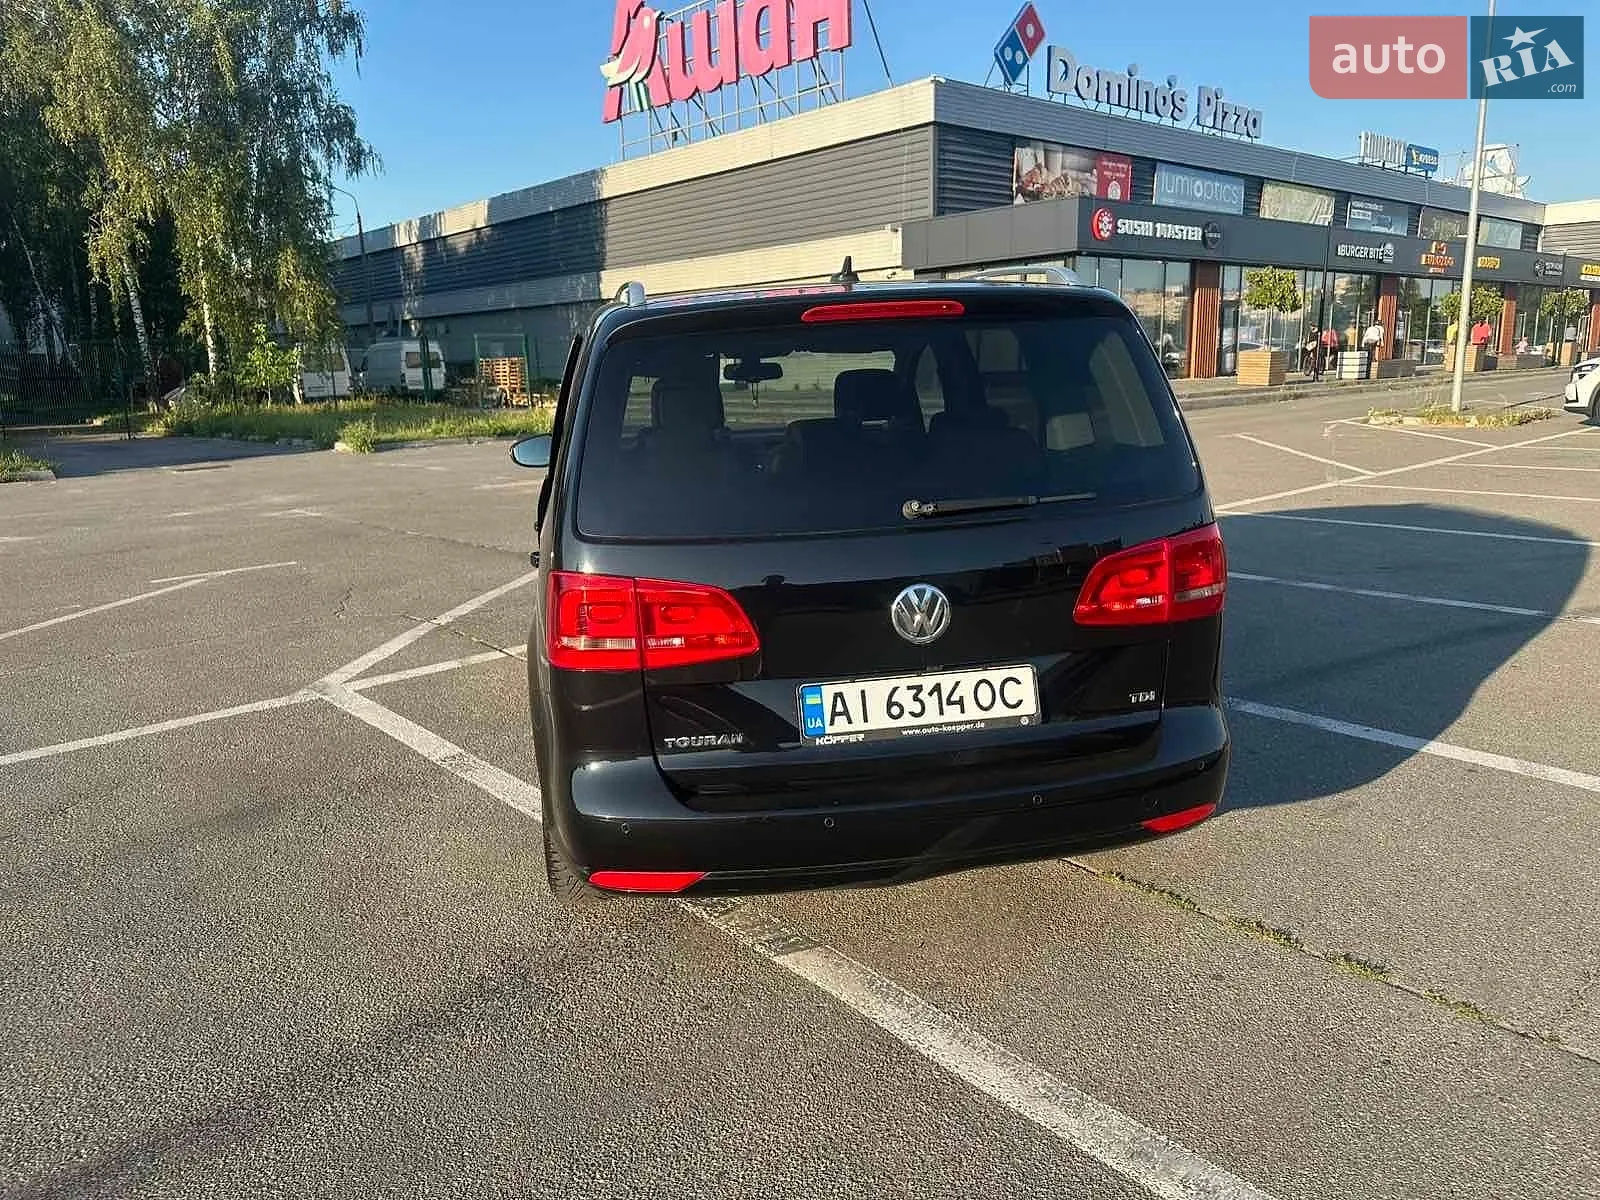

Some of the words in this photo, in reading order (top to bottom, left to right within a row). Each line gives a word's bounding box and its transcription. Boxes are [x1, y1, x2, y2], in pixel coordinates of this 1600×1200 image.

[1046, 44, 1189, 122] Domino's
[1196, 85, 1264, 139] Pizza
[1155, 222, 1203, 241] MASTER
[829, 689, 869, 727] AI
[886, 680, 966, 721] 6314
[807, 718, 824, 730] UA
[663, 731, 744, 748] TOURAN
